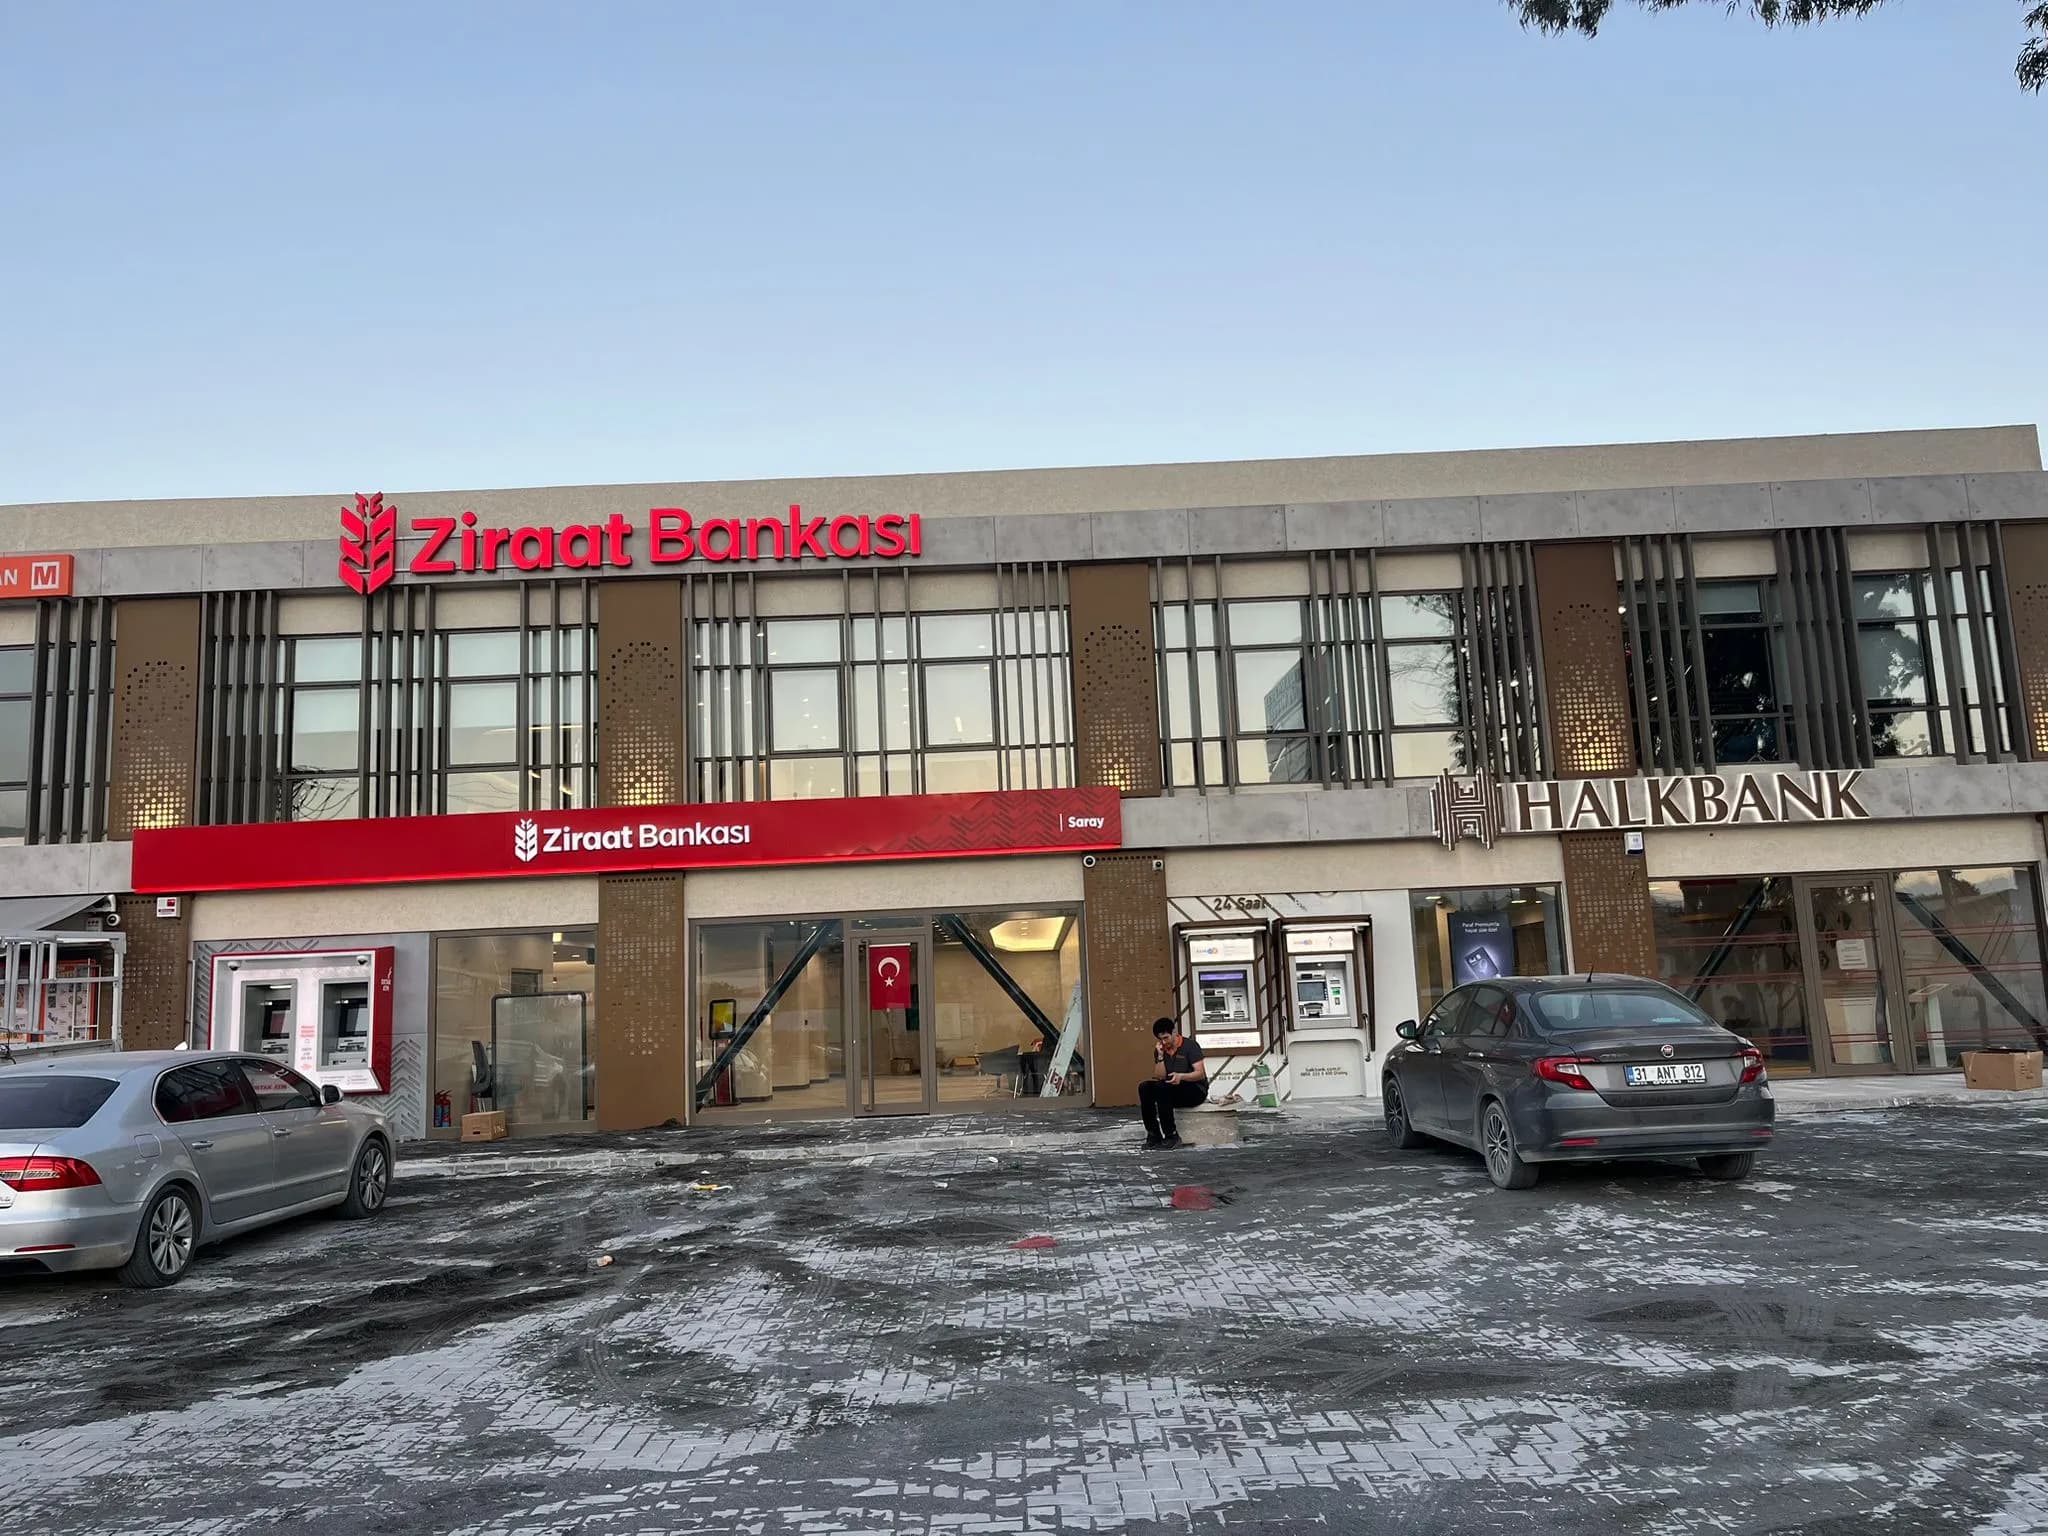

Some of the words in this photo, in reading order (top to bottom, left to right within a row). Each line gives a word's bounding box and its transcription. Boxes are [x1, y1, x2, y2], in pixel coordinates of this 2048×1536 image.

[410, 511, 633, 574] Ziraat
[649, 504, 921, 563] Bankası
[0, 568, 18, 586] N
[1514, 769, 1872, 831] HALKBANK
[1068, 816, 1105, 829] Saray
[542, 826, 633, 852] Ziraat
[638, 822, 750, 848] Bankası
[1213, 898, 1232, 911] 24
[1634, 1067, 1647, 1081] 31
[1656, 1066, 1677, 1080] ANT
[1683, 1065, 1703, 1079] 812
